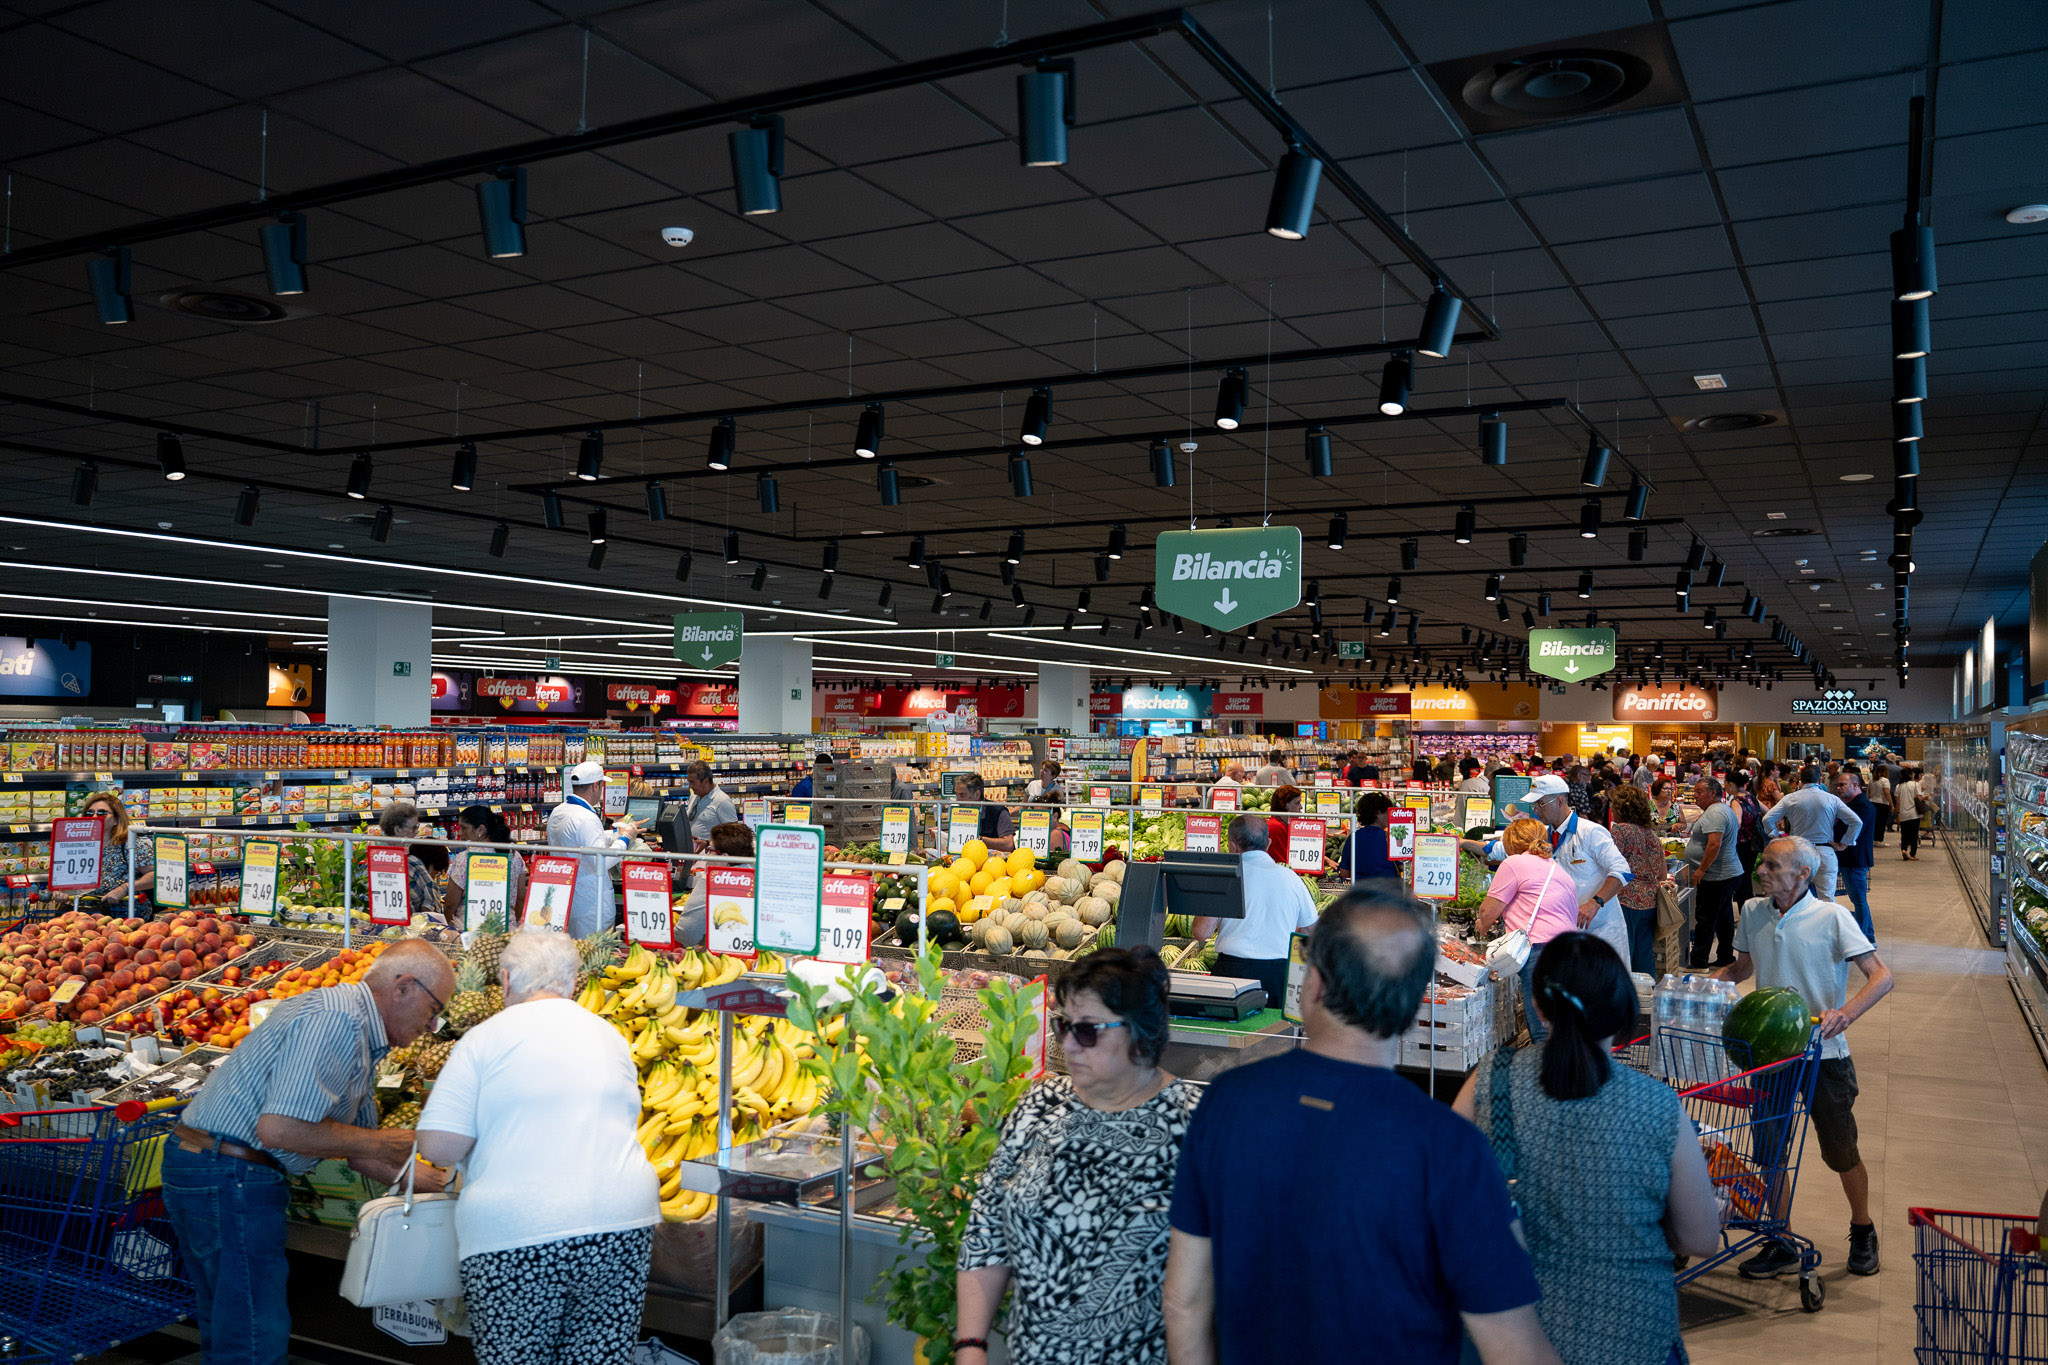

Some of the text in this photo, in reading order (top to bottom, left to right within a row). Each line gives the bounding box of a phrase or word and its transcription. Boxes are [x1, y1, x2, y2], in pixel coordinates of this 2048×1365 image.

[1172, 550, 1282, 581] Bilancia
[681, 625, 733, 642] Bilancia
[1539, 640, 1604, 656] Bilancia
[0, 650, 35, 676] ati
[487, 681, 527, 697] offerta
[616, 686, 650, 701] offerta
[909, 694, 946, 709] Macel
[1123, 694, 1188, 709] Pescheria
[1411, 694, 1466, 709] umeria
[1623, 692, 1706, 711] Panificio
[1792, 699, 1888, 711] SPAZIOSAPORE
[1392, 809, 1413, 818] offerta
[64, 821, 94, 832] prezzi
[1191, 818, 1216, 828] offerta
[1294, 821, 1321, 831] offerta
[66, 829, 92, 838] fermi
[777, 833, 801, 841] AVVISO
[890, 833, 906, 844] 3,79
[763, 840, 816, 850] ALLA CLIENTELA
[1029, 838, 1046, 850] 1,59
[1082, 841, 1099, 852] 1,99
[373, 851, 402, 863] offerta
[1299, 849, 1319, 862] 0,89
[67, 858, 95, 875] 0,99
[538, 860, 573, 875] offerta
[629, 867, 664, 880] offerta
[165, 876, 184, 893] 3,49
[713, 872, 751, 886] offerta
[1427, 871, 1452, 886] 2,99
[252, 883, 272, 900] 3,49
[825, 880, 865, 896] offerta
[383, 890, 403, 908] 1,89
[641, 910, 666, 930] 0,99
[732, 937, 754, 951] 0,99
[833, 928, 862, 950] 0,99
[379, 1304, 442, 1333] TERRABUONA
